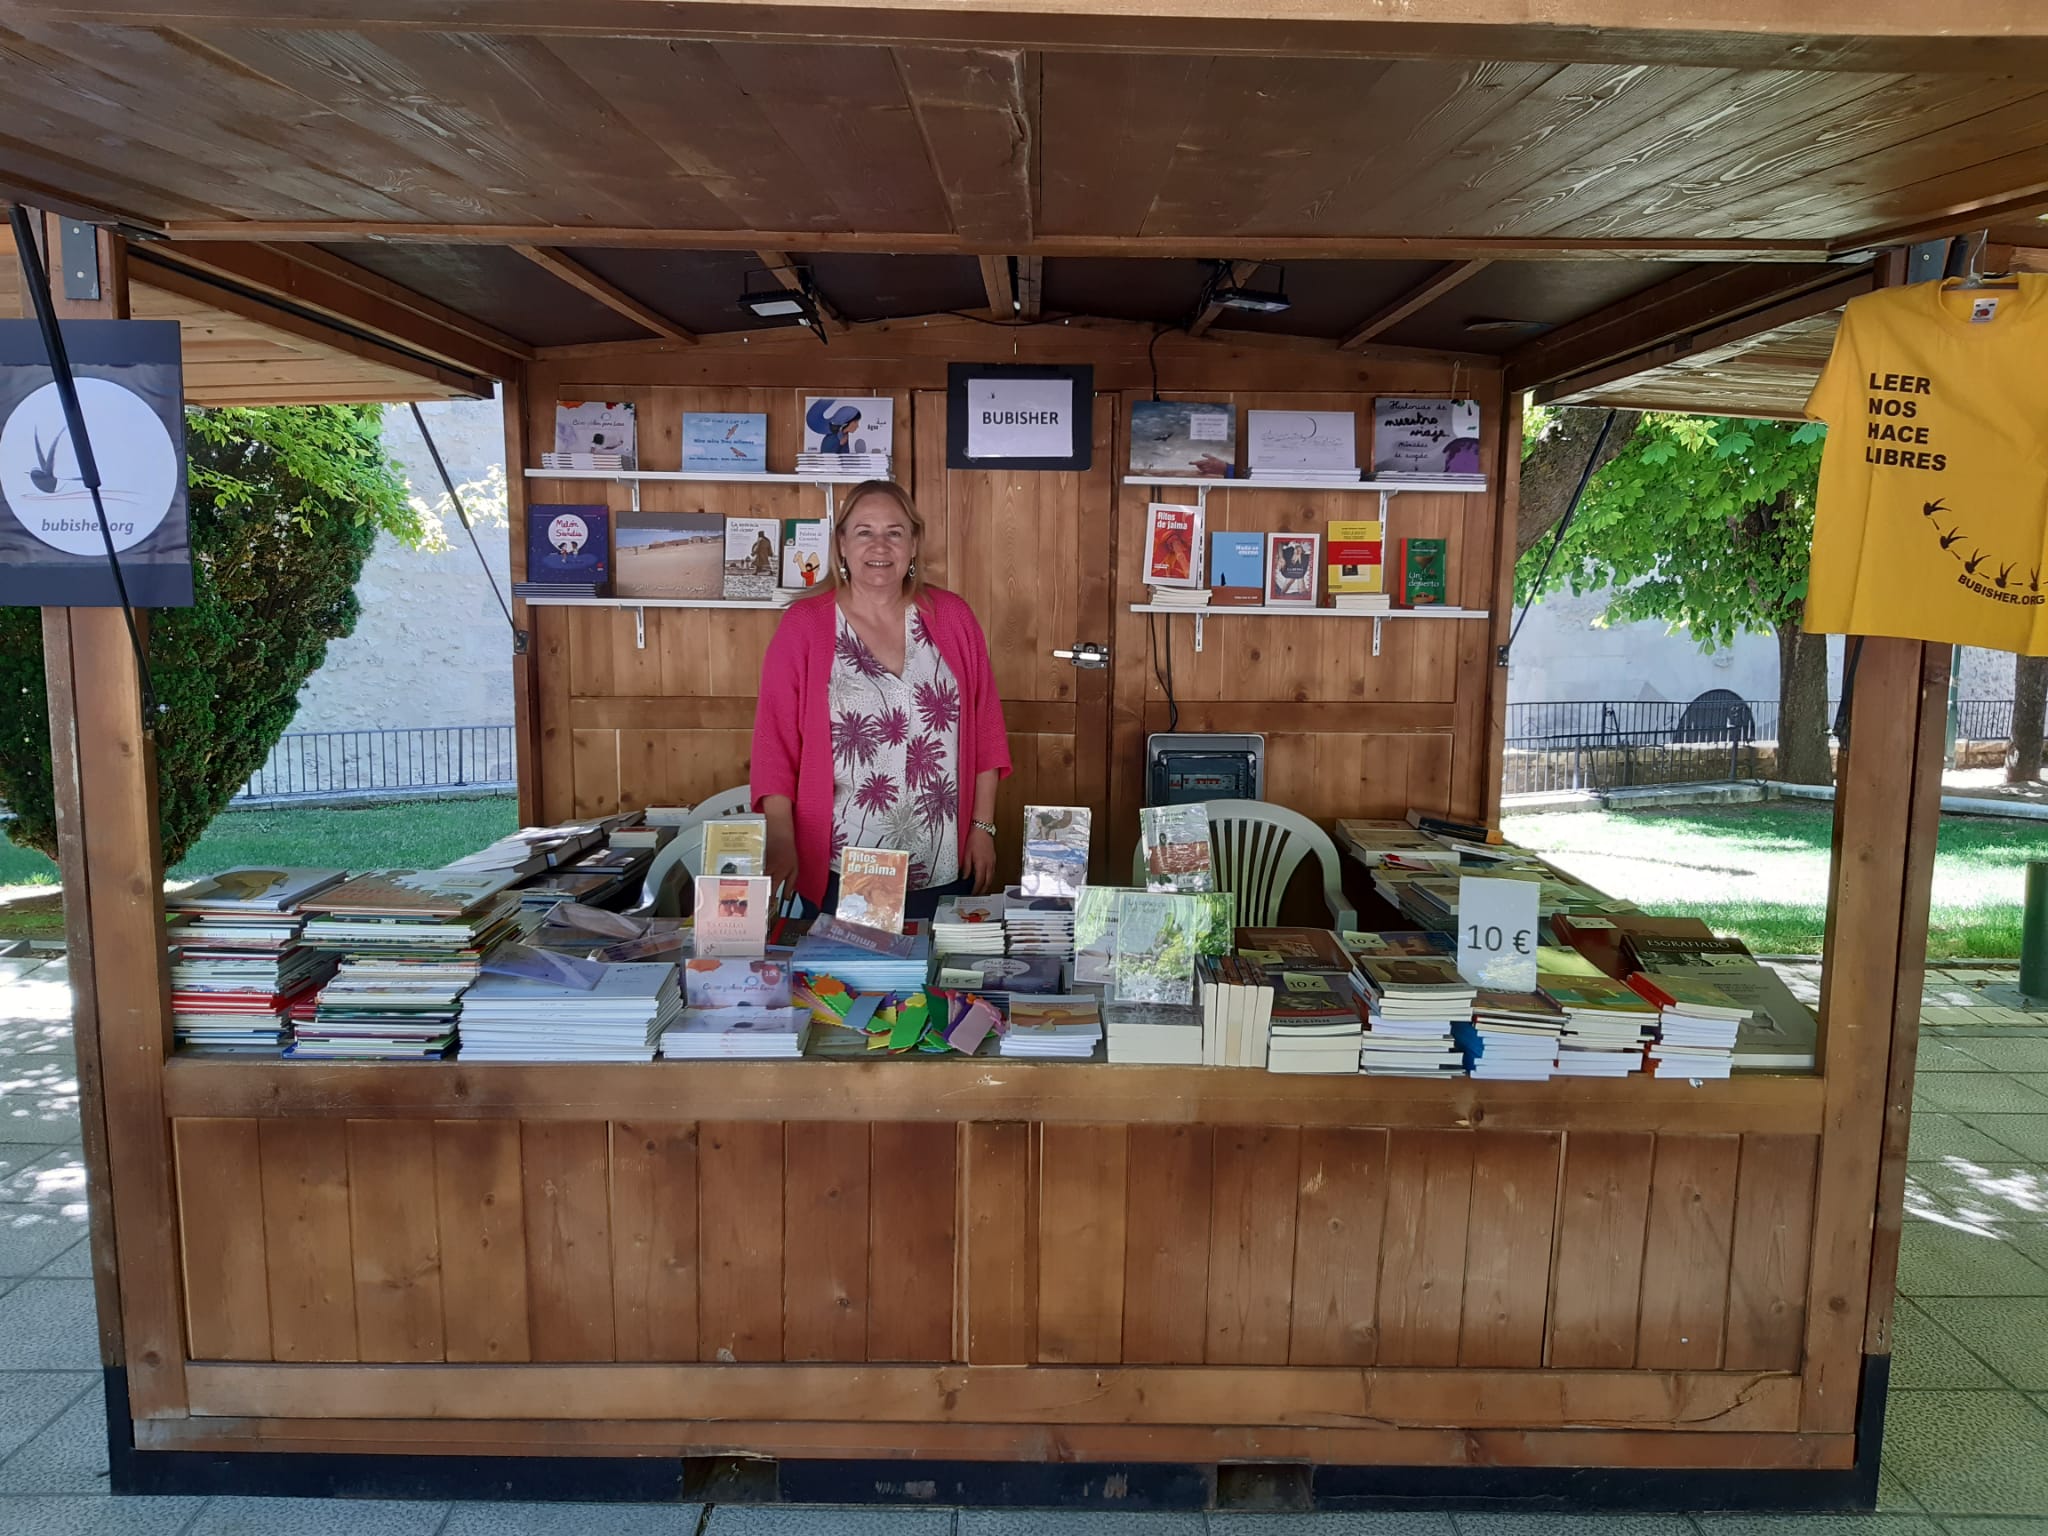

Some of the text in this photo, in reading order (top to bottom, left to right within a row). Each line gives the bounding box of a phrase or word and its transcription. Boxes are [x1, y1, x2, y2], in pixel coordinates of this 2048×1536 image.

[1869, 373, 1931, 395] LEER
[982, 411, 1059, 425] BUBISHER
[1868, 398, 1917, 418] NOS
[1868, 422, 1929, 444] HACE
[1866, 446, 1947, 471] LIBRES
[41, 518, 134, 535] bubisheorg
[1958, 574, 2046, 605] BUBISHER.ORG
[848, 851, 877, 863] Ritos
[847, 863, 862, 873] de
[1467, 924, 1532, 955] 10 €
[1647, 939, 1731, 949] ESGRAFIADO
